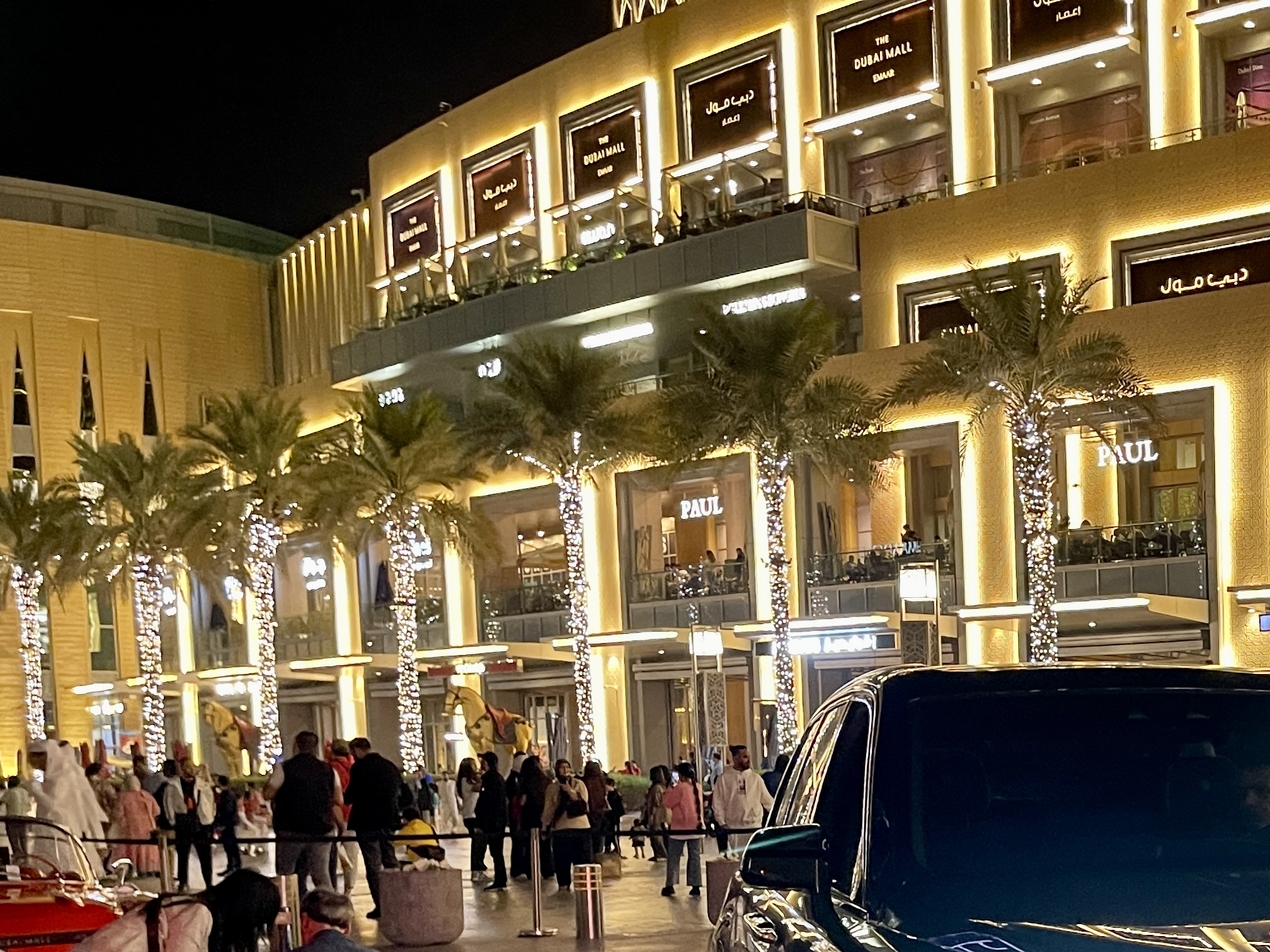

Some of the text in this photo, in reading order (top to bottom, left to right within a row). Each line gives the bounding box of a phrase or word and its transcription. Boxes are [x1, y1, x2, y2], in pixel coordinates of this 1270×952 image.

[875, 34, 890, 45] THE
[854, 41, 913, 70] DUBAI MALL
[872, 68, 896, 83] EMAAR
[583, 142, 626, 165] DUBAI MALL
[1159, 267, 1249, 295] دبي مول
[1097, 440, 1159, 467] PAUL
[680, 496, 723, 520] PAUL
